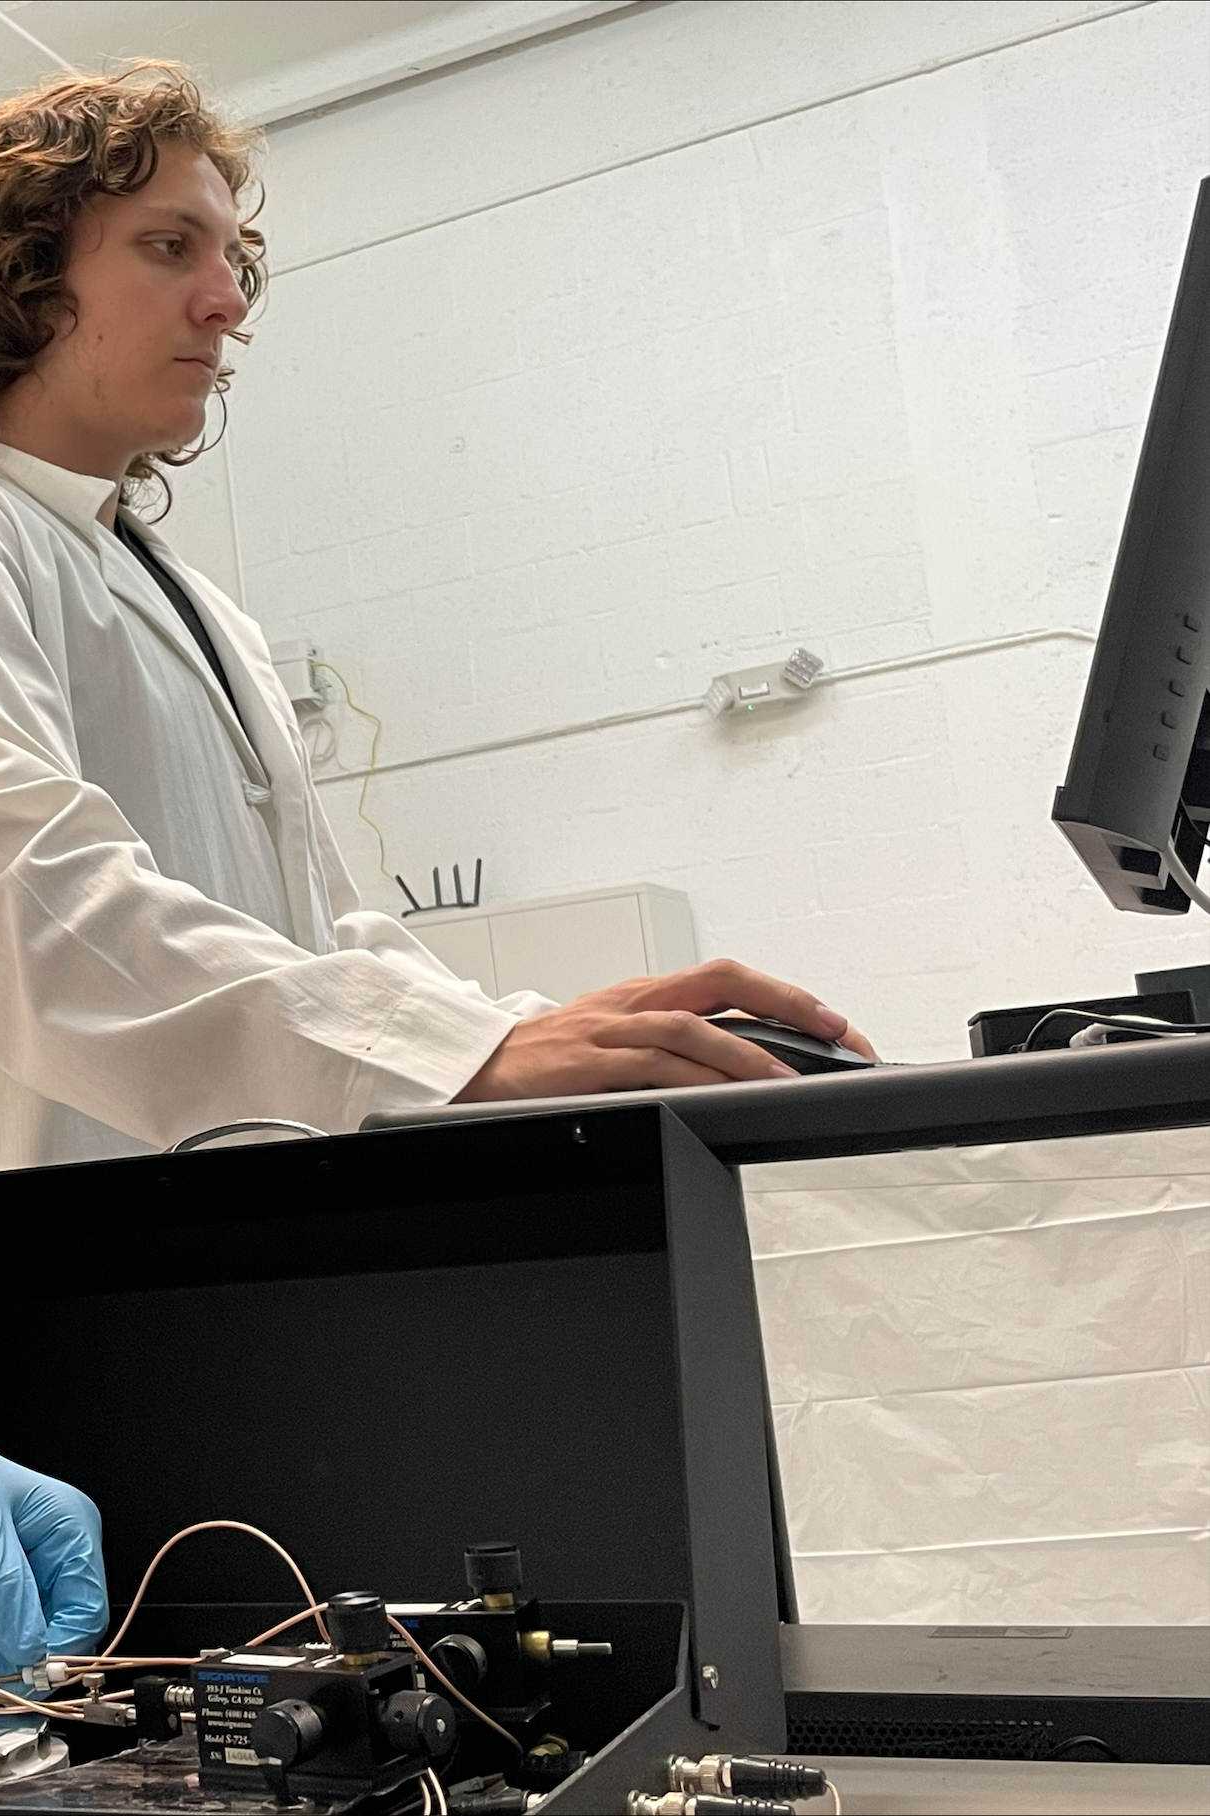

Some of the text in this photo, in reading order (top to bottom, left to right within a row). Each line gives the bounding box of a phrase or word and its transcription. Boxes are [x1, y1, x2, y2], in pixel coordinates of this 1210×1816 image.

[198, 1671, 269, 1684] SIGNATONE
[231, 1695, 242, 1704] CA
[204, 1733, 224, 1744] Model
